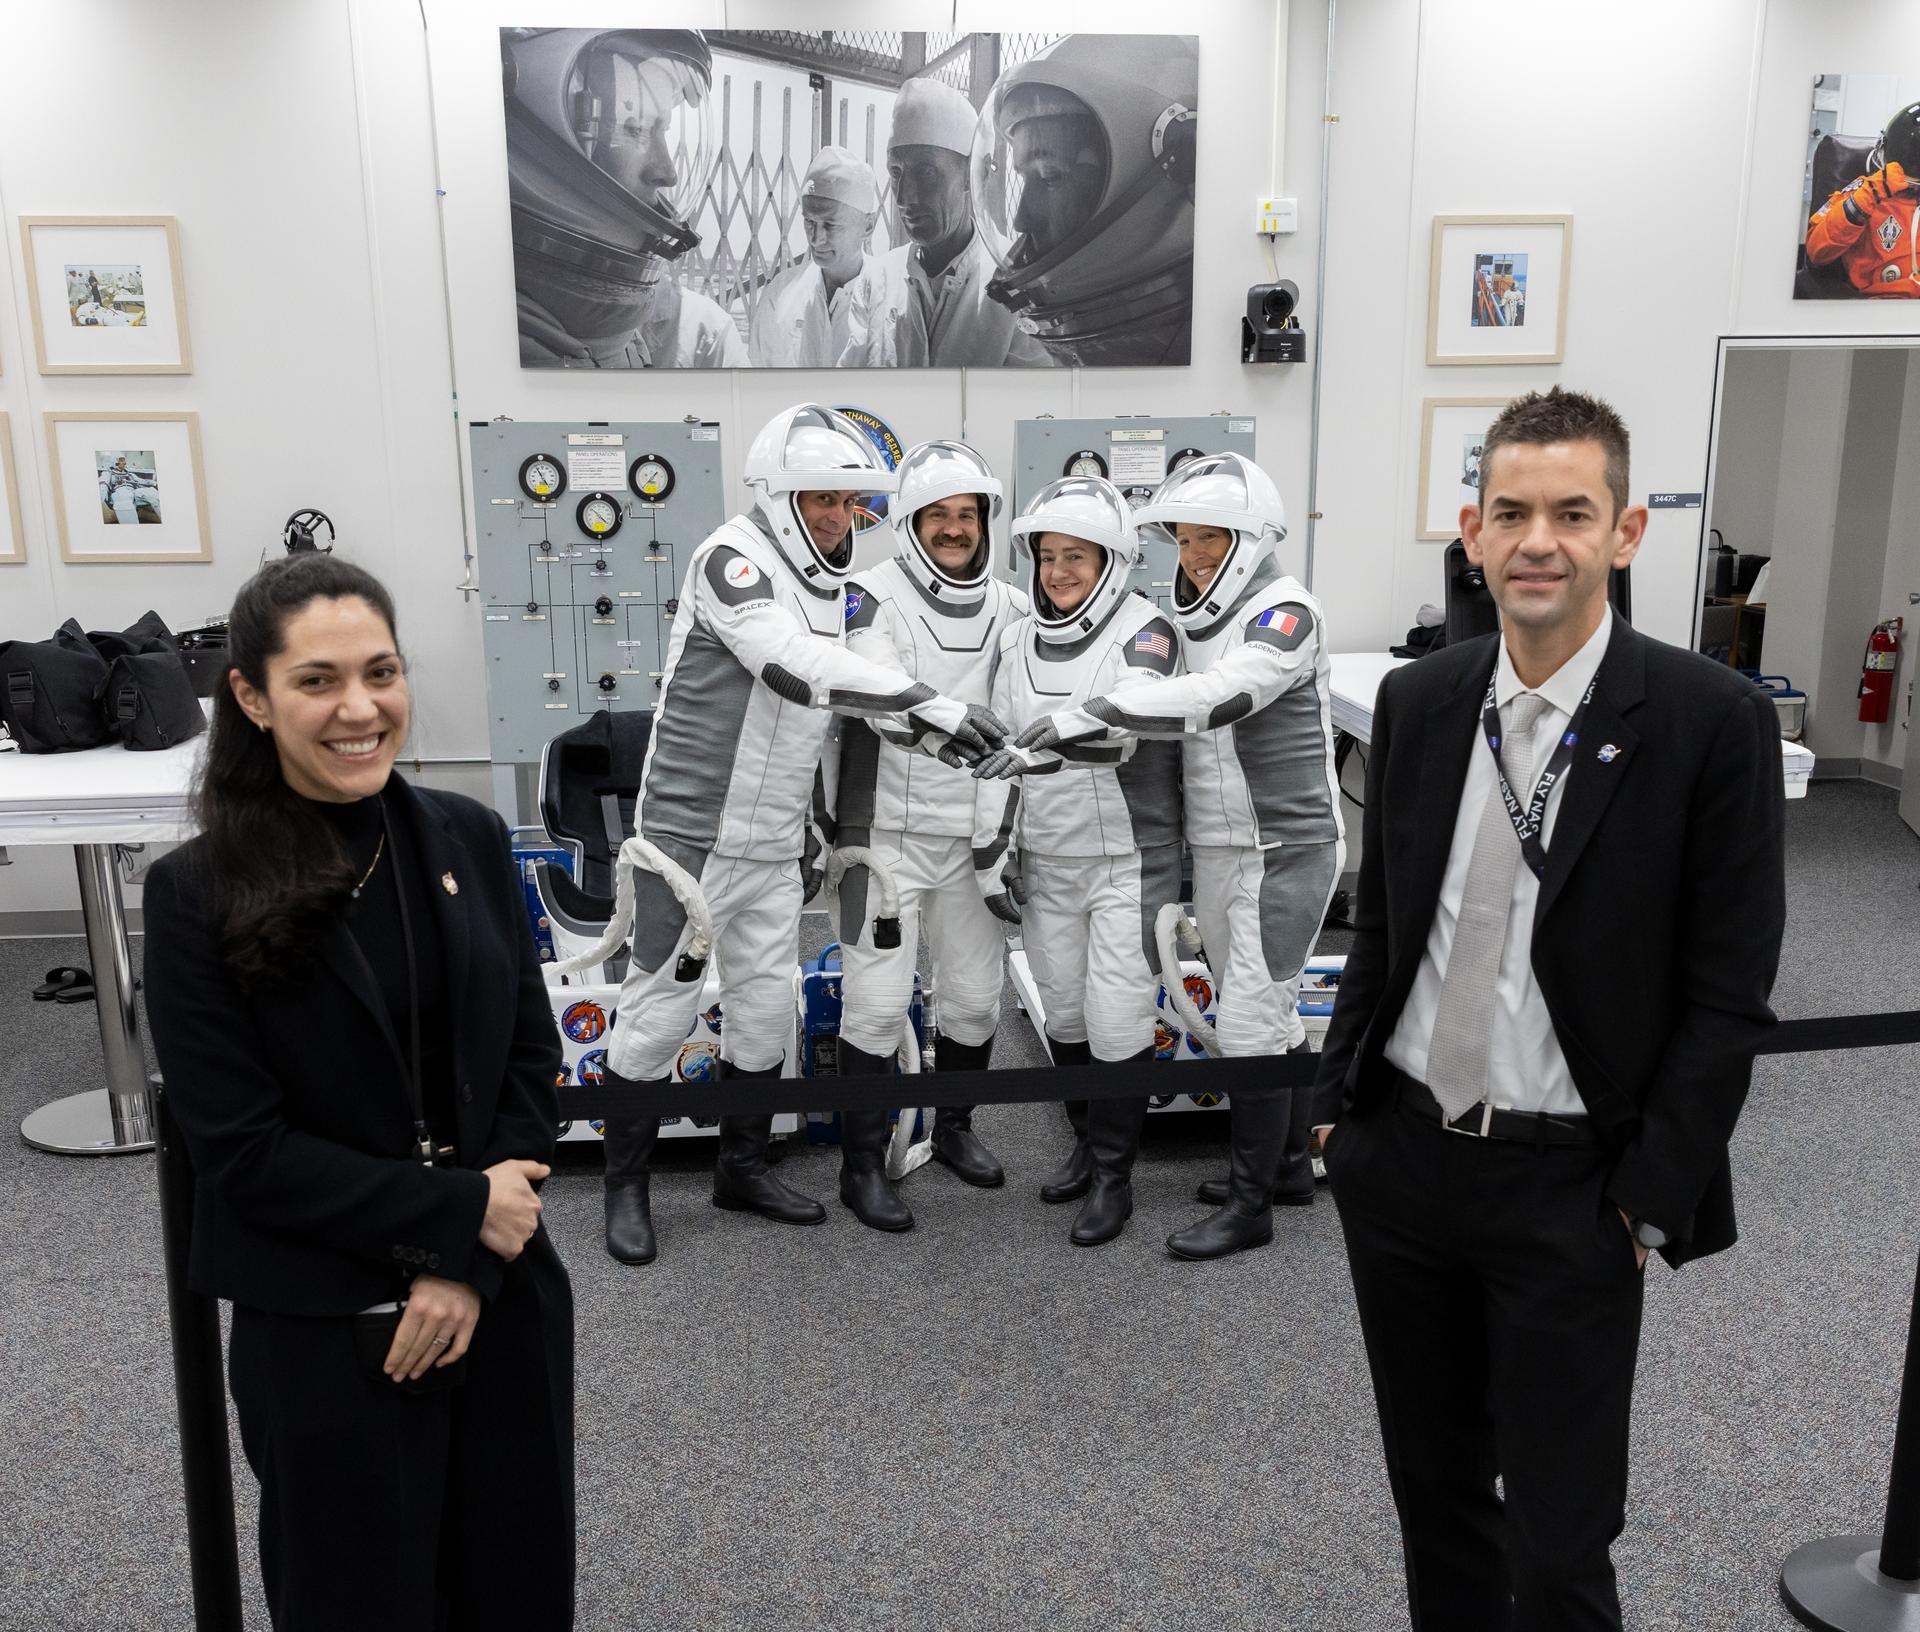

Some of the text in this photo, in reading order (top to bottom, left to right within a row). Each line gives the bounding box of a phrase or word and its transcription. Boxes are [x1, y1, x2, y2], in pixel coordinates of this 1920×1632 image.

[844, 411, 881, 430] THAWAY
[734, 601, 776, 616] SPACEX
[1536, 772, 1556, 798] FLY
[1512, 814, 1532, 840] FLY
